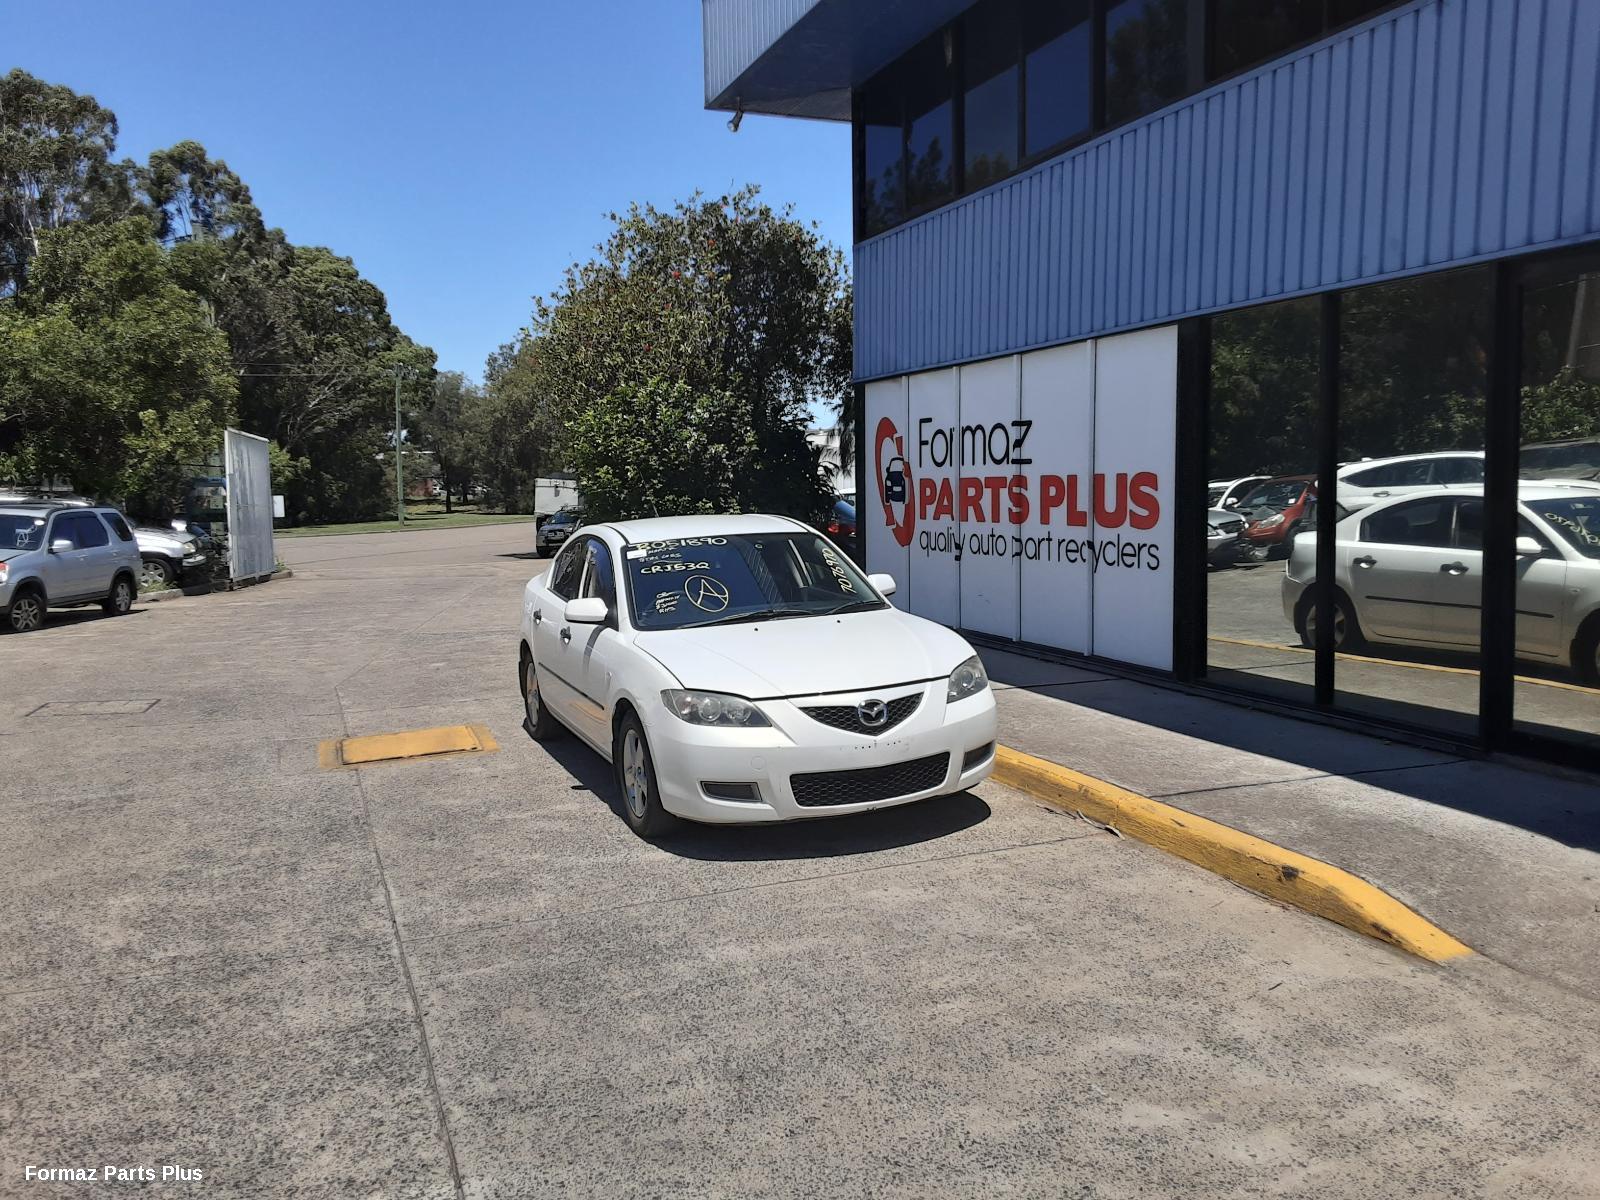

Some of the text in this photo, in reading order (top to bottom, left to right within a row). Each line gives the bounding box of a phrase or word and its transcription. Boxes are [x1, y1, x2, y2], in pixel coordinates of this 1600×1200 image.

[919, 471, 1160, 529] PARTS PLUS
[919, 526, 1160, 574] qualiy auto part recyclers
